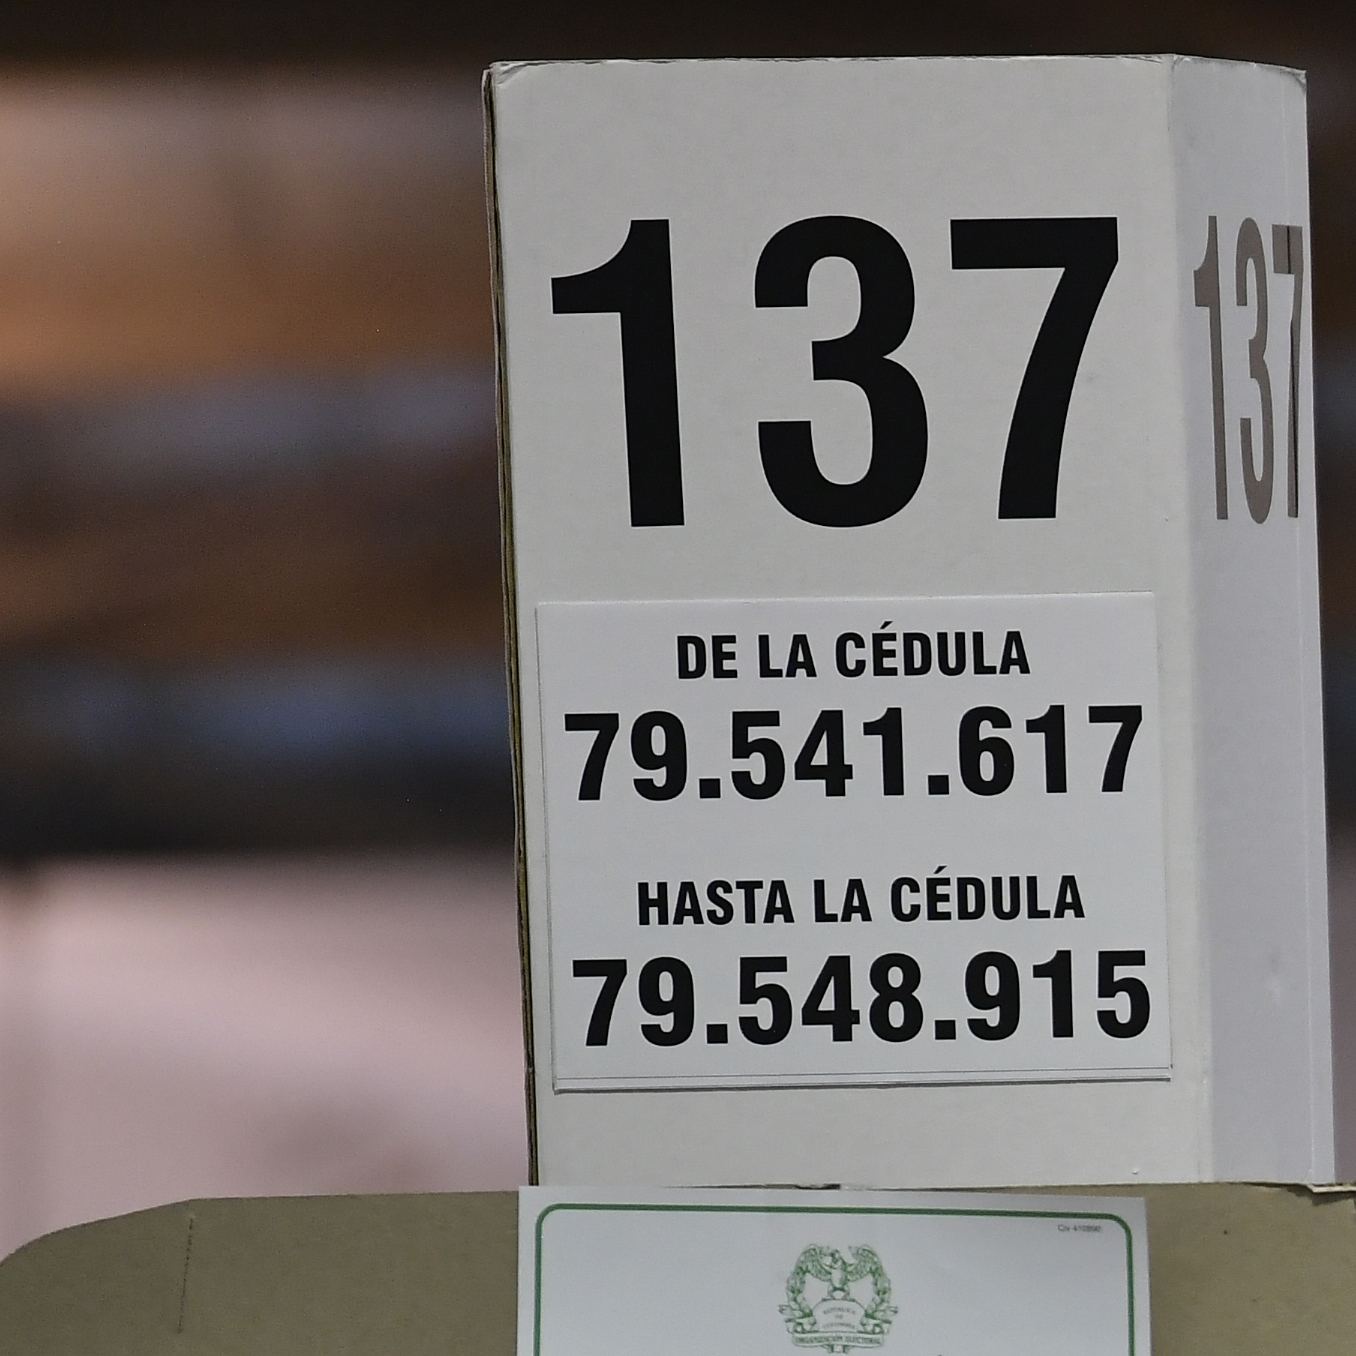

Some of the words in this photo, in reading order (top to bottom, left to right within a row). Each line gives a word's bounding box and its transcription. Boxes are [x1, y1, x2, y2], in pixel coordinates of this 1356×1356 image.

[551, 215, 1119, 528] 137
[1193, 215, 1304, 525] 137
[677, 635, 738, 680] DE
[759, 633, 817, 679] LA
[836, 621, 1031, 679] CÉDULA
[564, 704, 1144, 802] 79.541.617
[637, 879, 795, 926] HASTA
[813, 878, 873, 923] LA
[890, 865, 1086, 923] CÉDULA
[572, 949, 1151, 1047] 79.548.915
